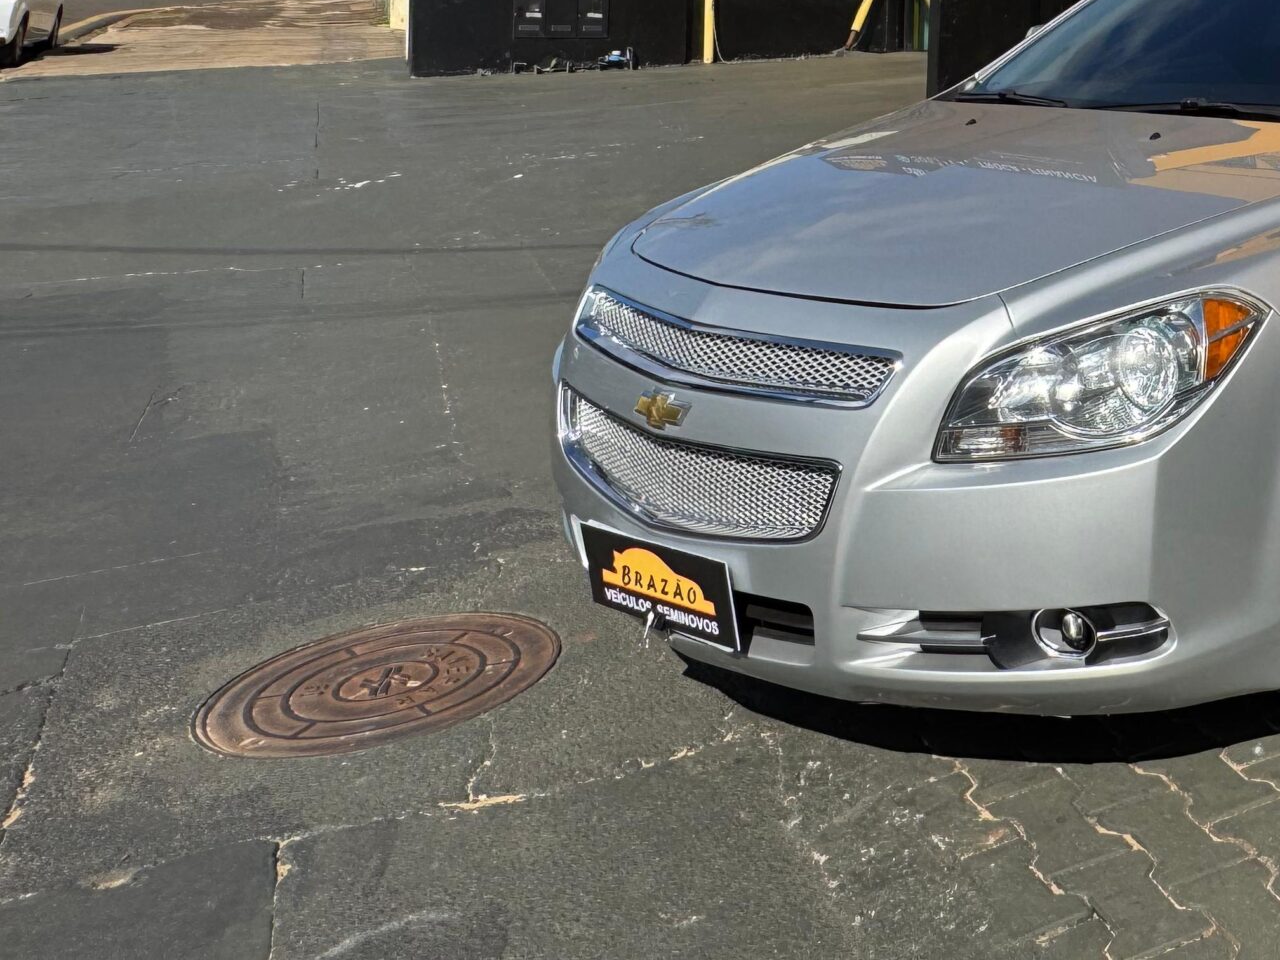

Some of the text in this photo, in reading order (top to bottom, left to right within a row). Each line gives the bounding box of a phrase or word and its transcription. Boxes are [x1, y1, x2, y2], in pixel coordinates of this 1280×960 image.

[621, 565, 697, 605] BRAZÃO
[604, 587, 719, 636] VEÍCULOS SEMINOVOS
